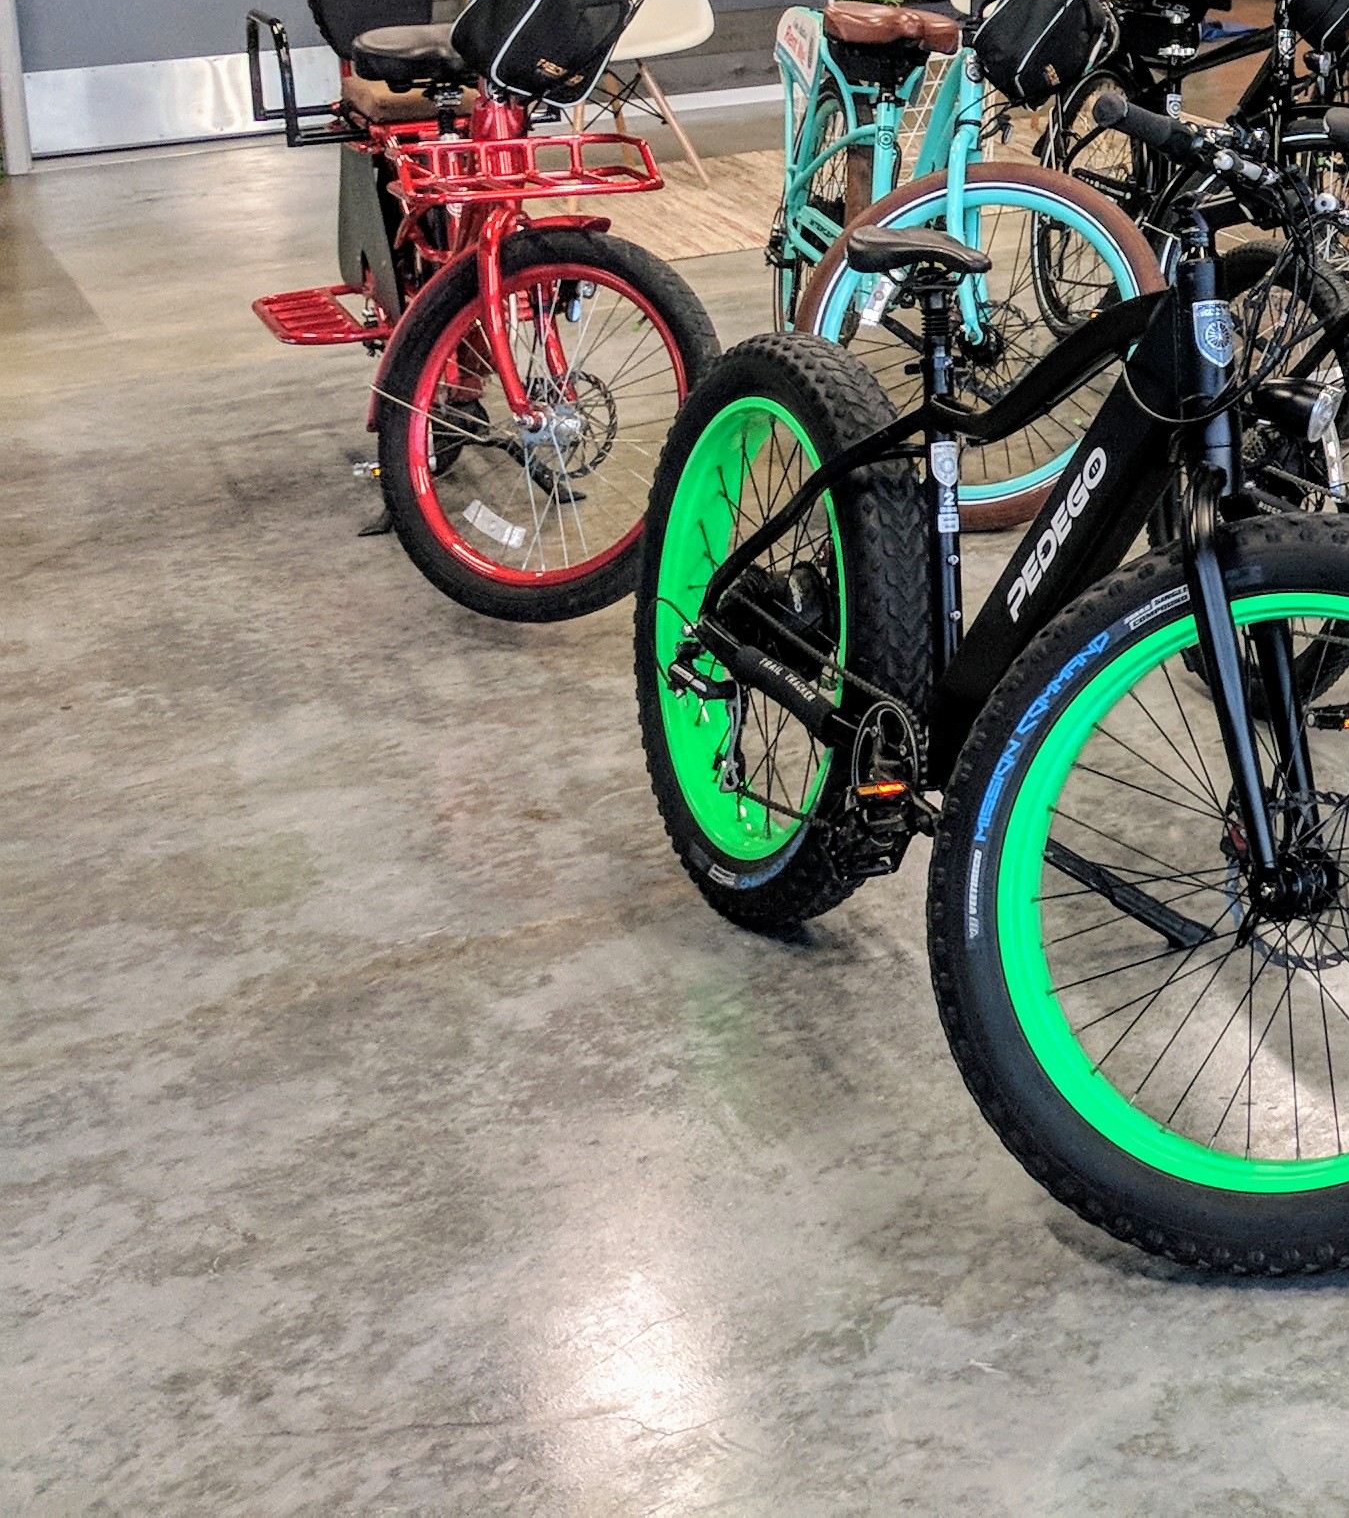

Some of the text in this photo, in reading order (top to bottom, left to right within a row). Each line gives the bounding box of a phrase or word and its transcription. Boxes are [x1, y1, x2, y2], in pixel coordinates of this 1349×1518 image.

[943, 492, 955, 506] 2
[1007, 445, 1108, 622] PEDEGO
[759, 658, 816, 702] TRAIL TRACKER
[973, 631, 1112, 844] MISSION COMMAND
